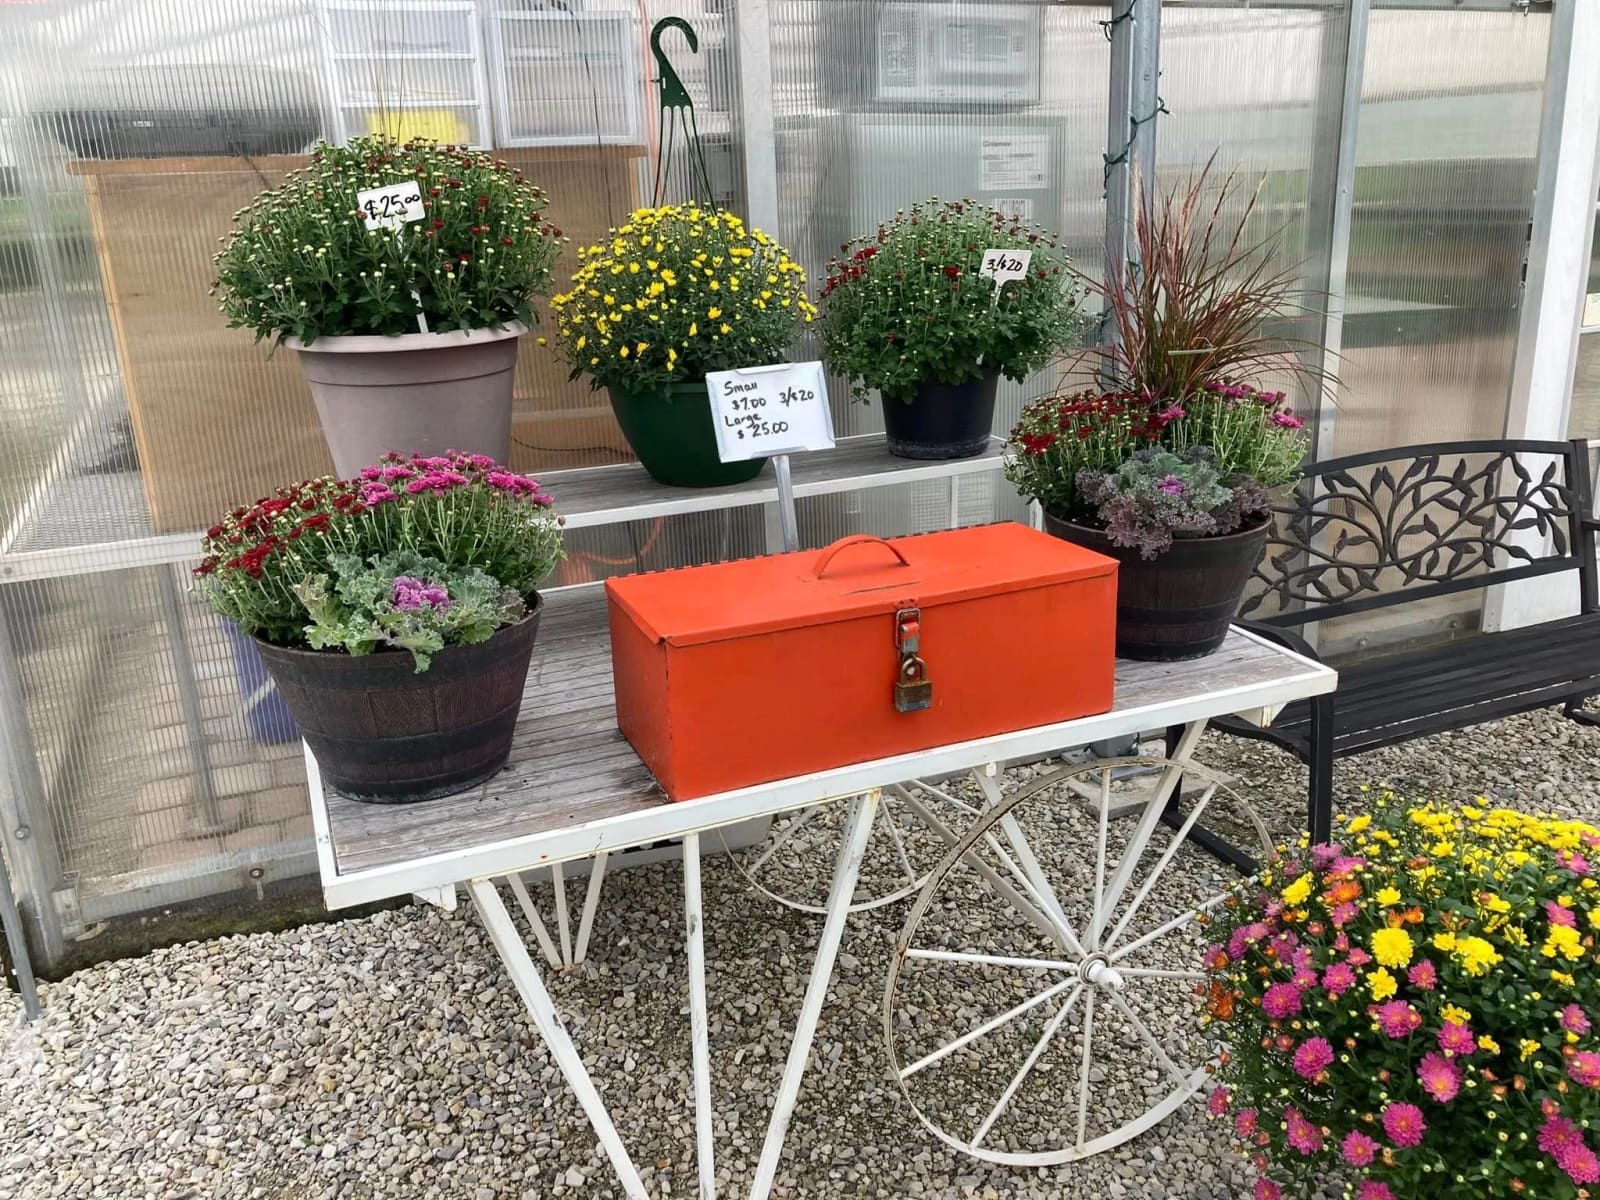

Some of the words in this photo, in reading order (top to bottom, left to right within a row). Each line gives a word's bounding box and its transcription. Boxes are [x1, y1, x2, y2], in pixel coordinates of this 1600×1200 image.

[723, 381, 757, 397] Small
[731, 397, 767, 411] $7.00
[724, 412, 762, 429] Large
